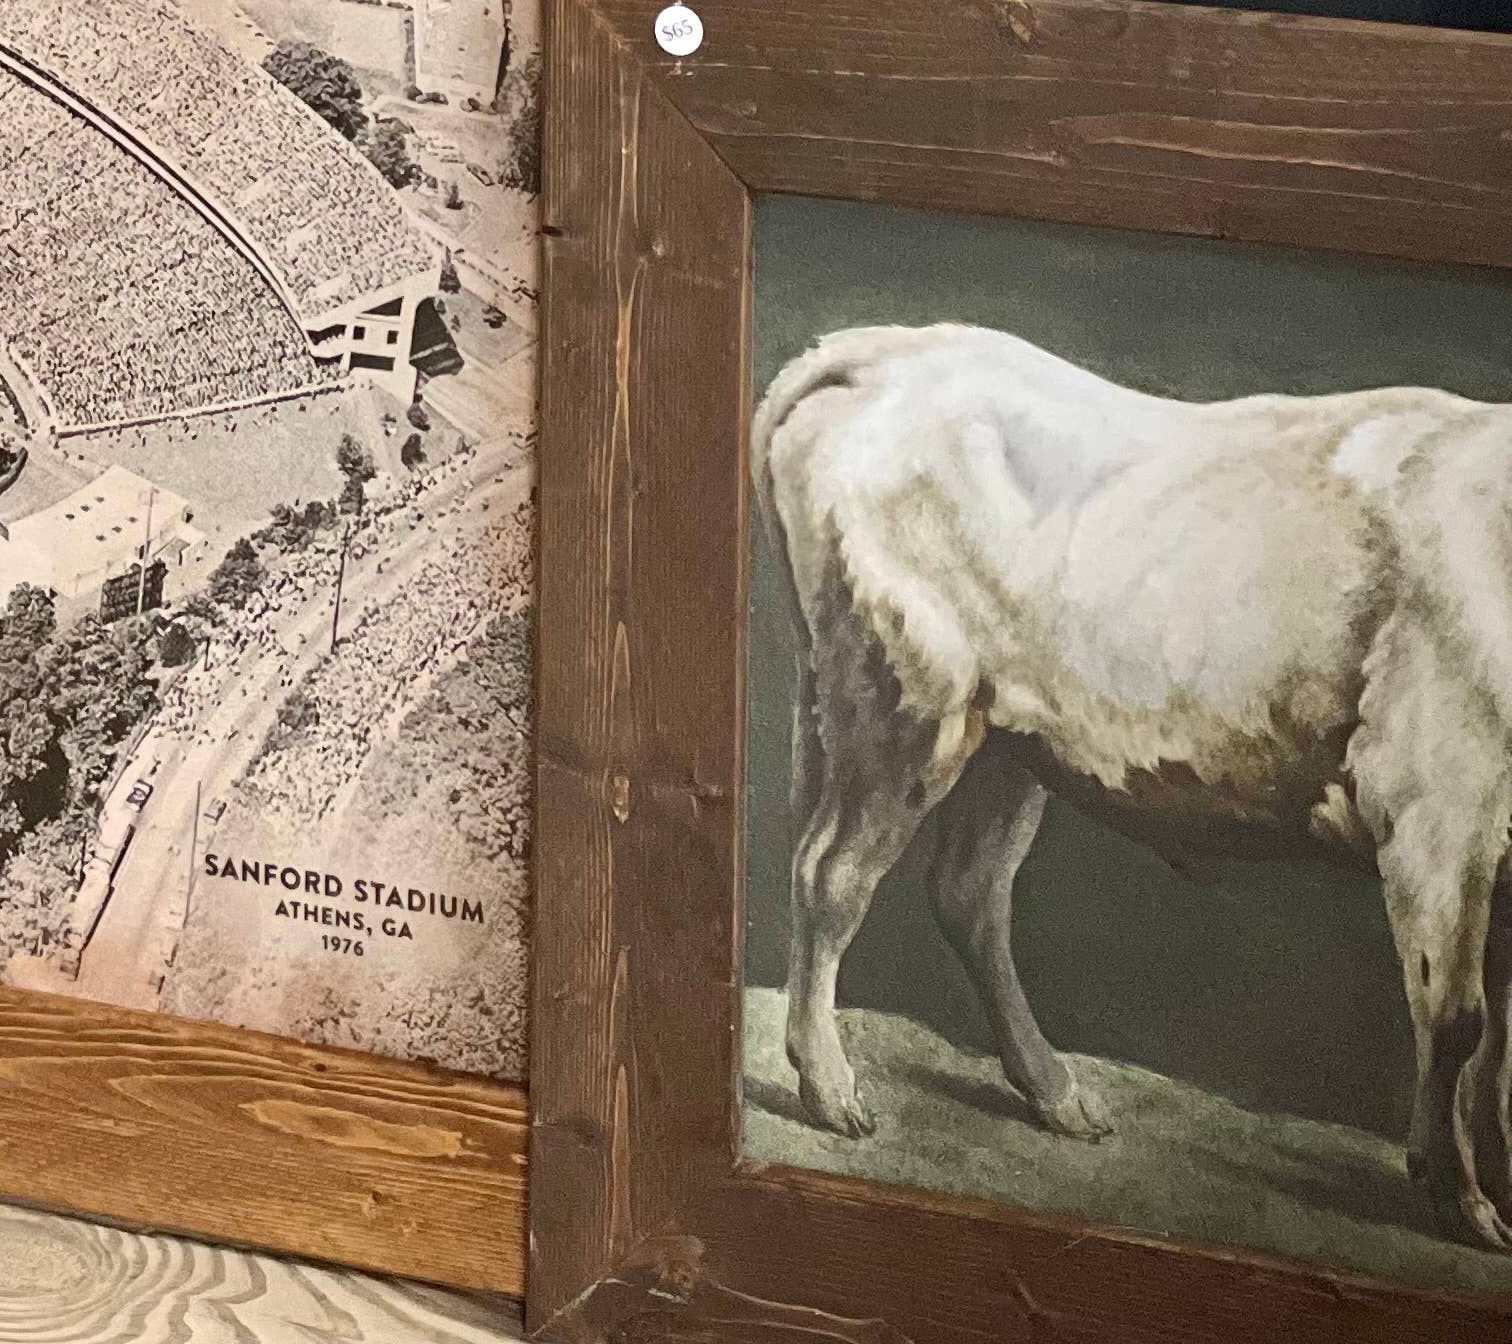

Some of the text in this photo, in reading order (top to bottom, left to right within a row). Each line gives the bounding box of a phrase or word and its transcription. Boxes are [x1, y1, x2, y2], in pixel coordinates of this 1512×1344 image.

[662, 19, 693, 42] $65
[205, 853, 485, 924] SANFORD STADIUM
[275, 900, 413, 940] ATHENS, GA
[322, 935, 364, 957] 1976
